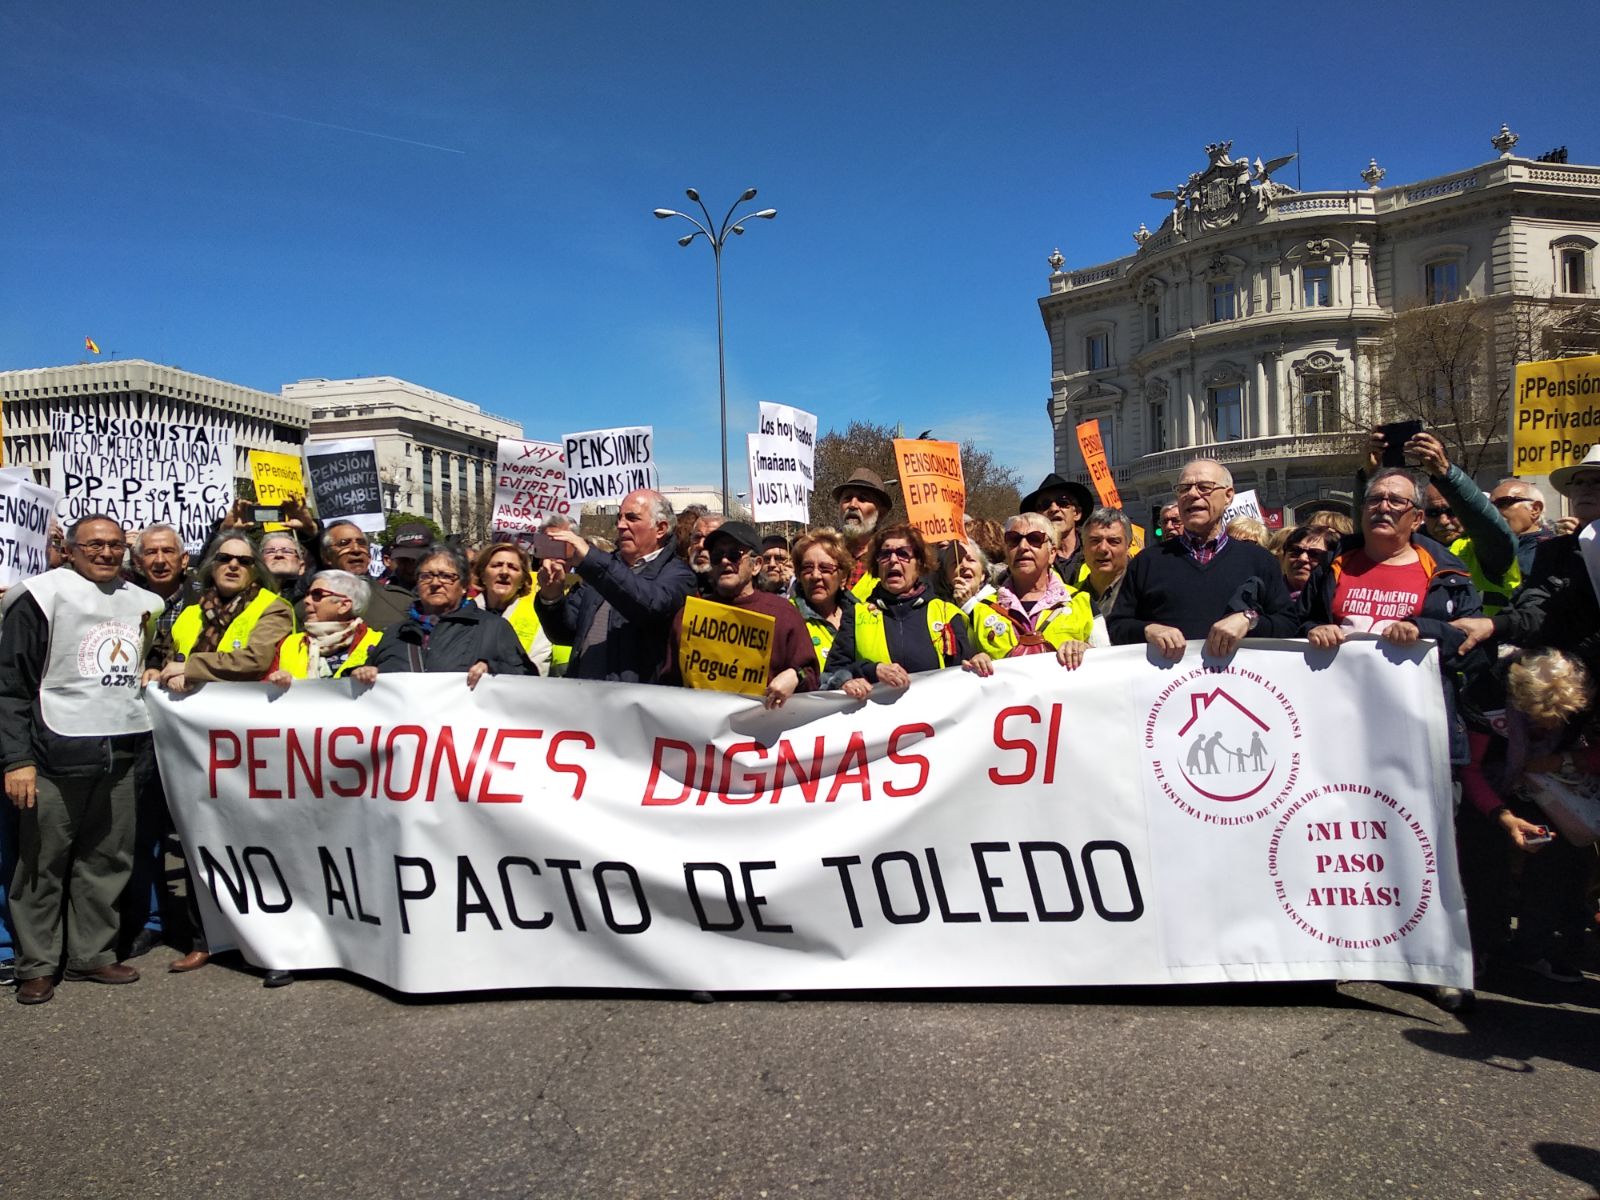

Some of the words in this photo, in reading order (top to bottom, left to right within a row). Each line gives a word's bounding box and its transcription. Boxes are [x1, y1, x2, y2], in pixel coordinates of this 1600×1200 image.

[761, 414, 775, 436] Los
[777, 417, 793, 442] hoy
[1519, 405, 1600, 430] PPrivada
[51, 431, 88, 455] ANTES
[91, 434, 104, 456] DE
[107, 435, 143, 459] METER
[147, 439, 160, 461] EN
[164, 441, 179, 462] LA
[182, 441, 222, 467] URNA
[566, 433, 650, 469] PENSIONES
[759, 452, 797, 472] mañana
[1517, 444, 1545, 467] por
[63, 454, 93, 477] UNA
[100, 456, 179, 481] PAPELETA
[311, 452, 371, 480] PENSIÓN
[313, 471, 378, 496] ERMANENTE
[568, 472, 624, 500] DIGNAS
[757, 482, 793, 507] JUSTA,
[909, 483, 922, 506] El
[922, 482, 938, 504] PP
[152, 502, 172, 523] LA
[180, 502, 227, 523] MANO
[497, 503, 544, 521] AHORA
[925, 513, 947, 536] roba
[494, 518, 540, 533] PODEMO
[1342, 599, 1372, 615] PARA
[1346, 587, 1419, 605] TRATAMIENTO
[687, 614, 770, 651] ¡LADRONES!
[685, 649, 739, 681] ¡Pagué
[742, 665, 765, 684] mi
[1145, 675, 1189, 749] COORDINADORA
[1189, 665, 1237, 679] ESTATAL
[1240, 668, 1263, 684] POR
[1264, 680, 1278, 693] LA
[1276, 692, 1302, 739] DEFENSA
[208, 725, 596, 803] PENSIONES
[641, 722, 935, 806] DIGNAS
[988, 703, 1063, 786] SI
[1153, 760, 1165, 782] DEL
[1161, 782, 1201, 819] SISTEMA
[1204, 813, 1254, 826] PÚBLICO
[1256, 806, 1272, 819] DE
[1270, 752, 1300, 810] PENSIONES
[1307, 822, 1342, 842] ¡NI
[1350, 821, 1387, 840] UN
[1322, 783, 1372, 795] MADRID
[1374, 790, 1398, 809] POR
[1398, 807, 1412, 822] LA
[1410, 822, 1436, 875] DEFENSA
[1316, 853, 1384, 873] PASO
[199, 846, 293, 914] NO
[318, 846, 381, 926] AL
[394, 855, 652, 935] PACTO
[684, 861, 793, 933] DE
[822, 840, 1145, 928] TOLEDO
[1306, 881, 1401, 907] ATRÁS!
[1274, 880, 1287, 902] DEL
[1282, 902, 1324, 941] SISTEMA
[1327, 935, 1381, 950] PÚBLICO
[1383, 931, 1400, 945] DE
[1399, 879, 1432, 936] PENSIONES
